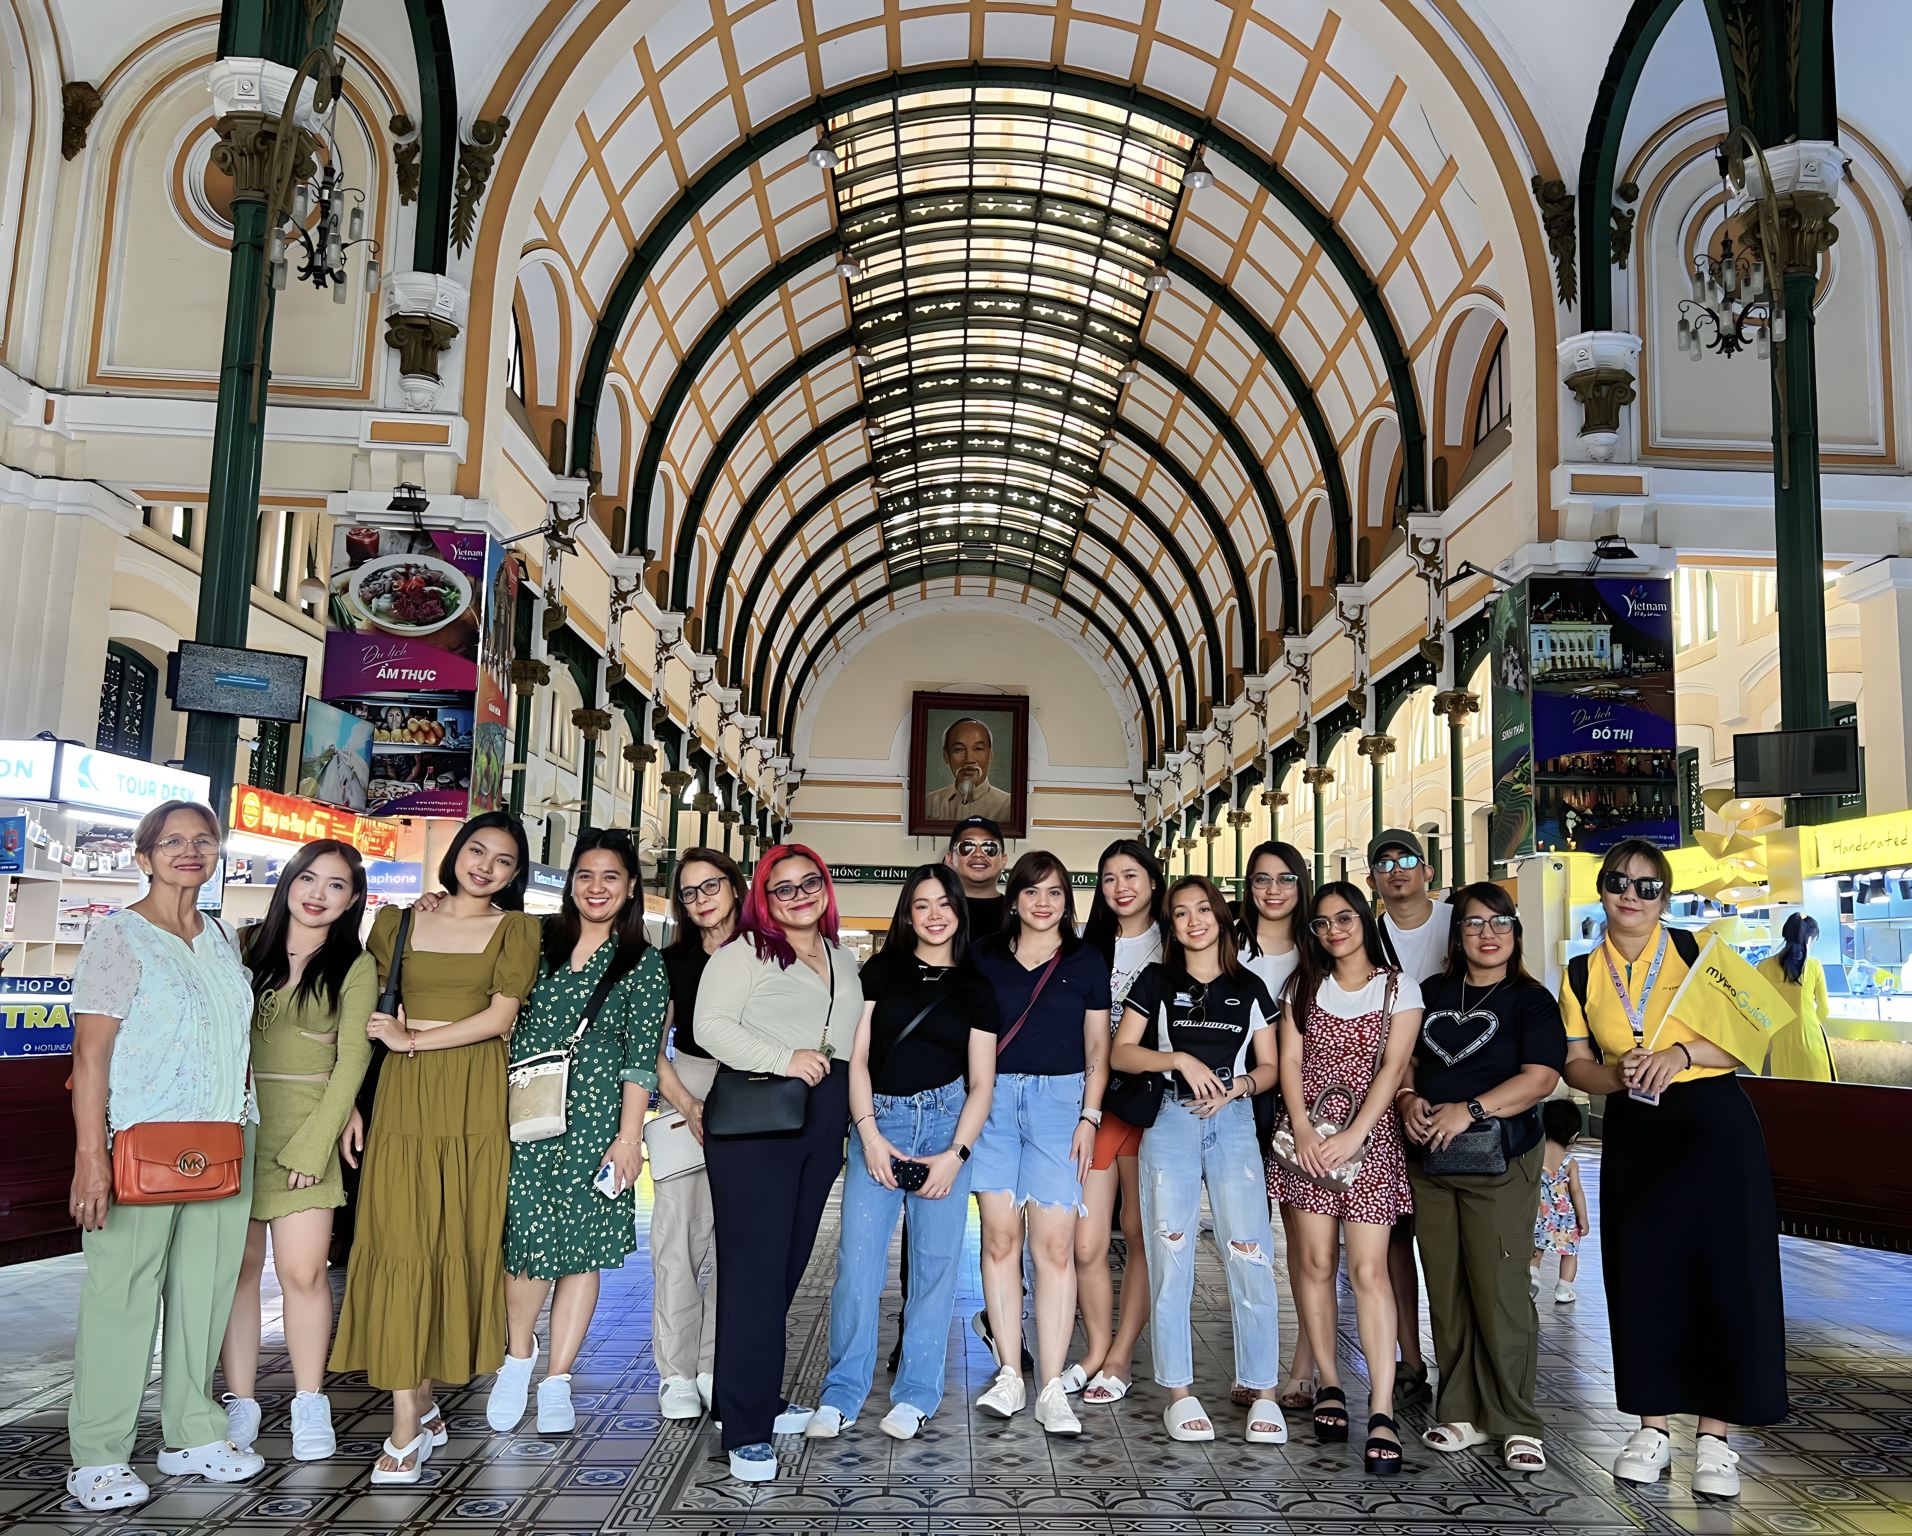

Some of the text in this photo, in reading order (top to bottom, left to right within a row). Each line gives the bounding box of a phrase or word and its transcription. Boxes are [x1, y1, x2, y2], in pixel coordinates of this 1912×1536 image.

[450, 543, 483, 560] Vietnam
[1621, 594, 1667, 617] Vietnam
[400, 669, 437, 683] THỰC
[1592, 726, 1634, 743] ĐÔ THỊ
[117, 774, 157, 798] TOUR
[873, 867, 908, 878] CHÍNH
[16, 980, 54, 992] HOP
